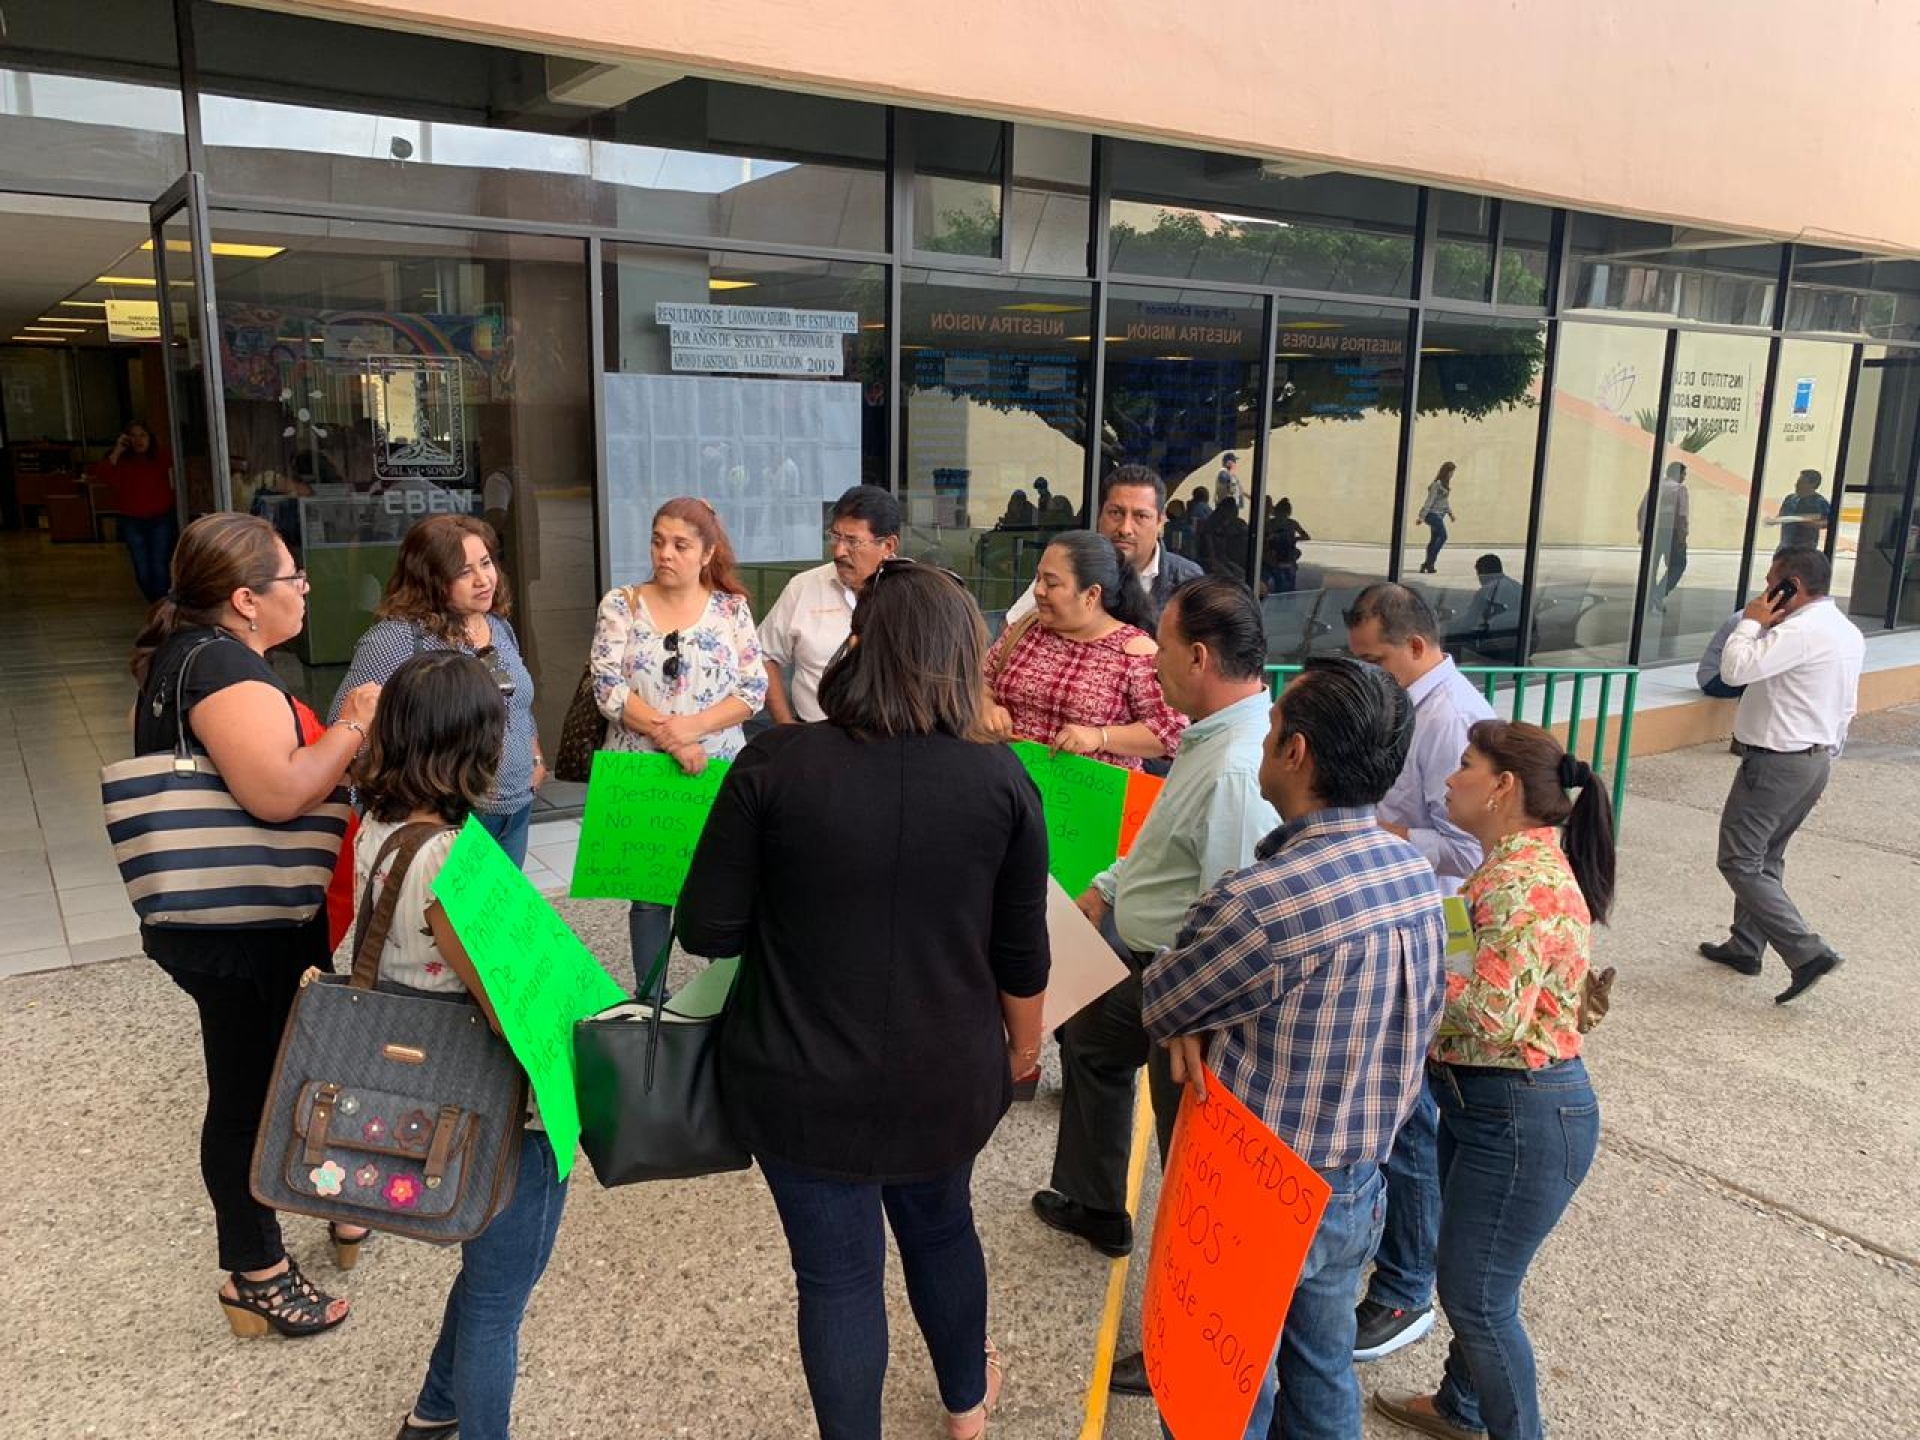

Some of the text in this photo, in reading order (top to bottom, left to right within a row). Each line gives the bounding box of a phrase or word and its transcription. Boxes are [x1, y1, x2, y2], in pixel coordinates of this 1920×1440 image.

[658, 306, 710, 325] RESULTADOS
[712, 310, 723, 325] DE
[795, 313, 807, 328] DE
[673, 330, 690, 346] POR
[693, 328, 718, 347] AÑOS
[719, 332, 730, 347] DE
[807, 356, 835, 373] 2019
[604, 808, 688, 833] No nos
[1053, 818, 1079, 843] de
[590, 839, 606, 853] el
[621, 840, 668, 860] pago
[1202, 1312, 1255, 1395] 2016
